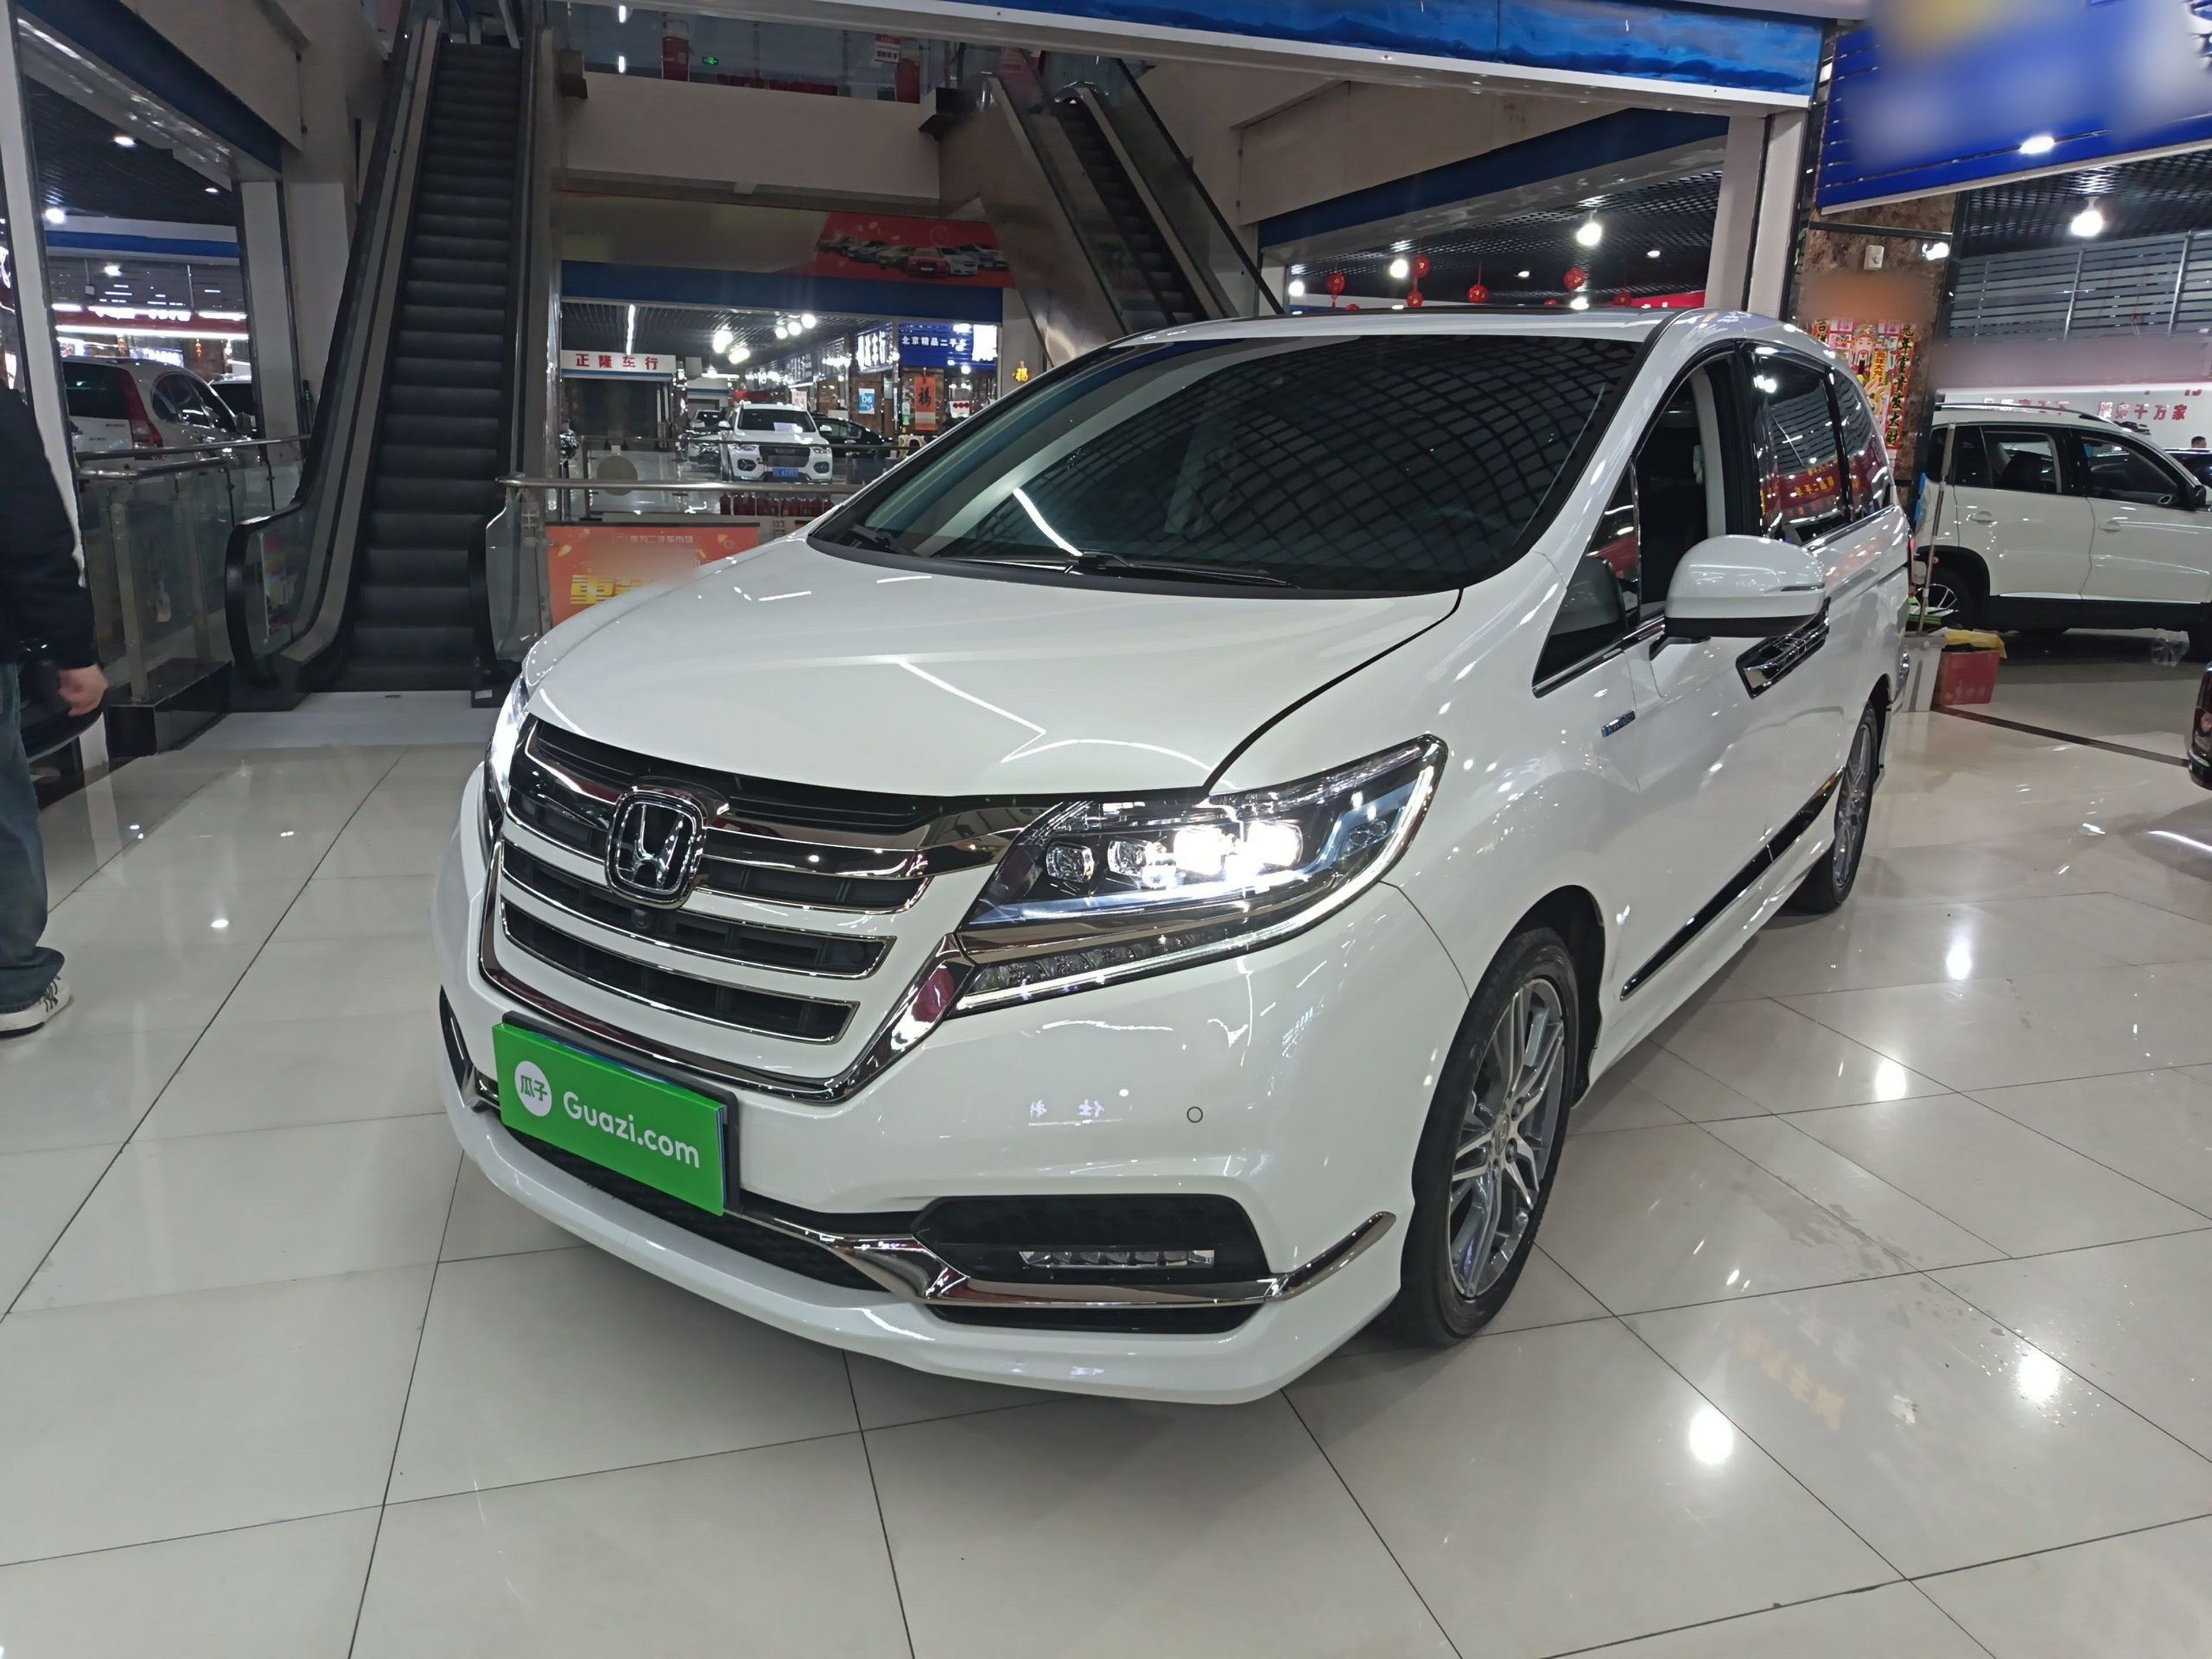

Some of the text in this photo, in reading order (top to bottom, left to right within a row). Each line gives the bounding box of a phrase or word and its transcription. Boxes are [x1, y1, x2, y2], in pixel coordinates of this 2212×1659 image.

[902, 336, 967, 347] 北京精品二手车
[575, 353, 658, 370] 正隆车行
[862, 393, 872, 403] D6
[520, 1075, 548, 1101] 瓜子
[563, 1091, 699, 1169] Guazi.com
